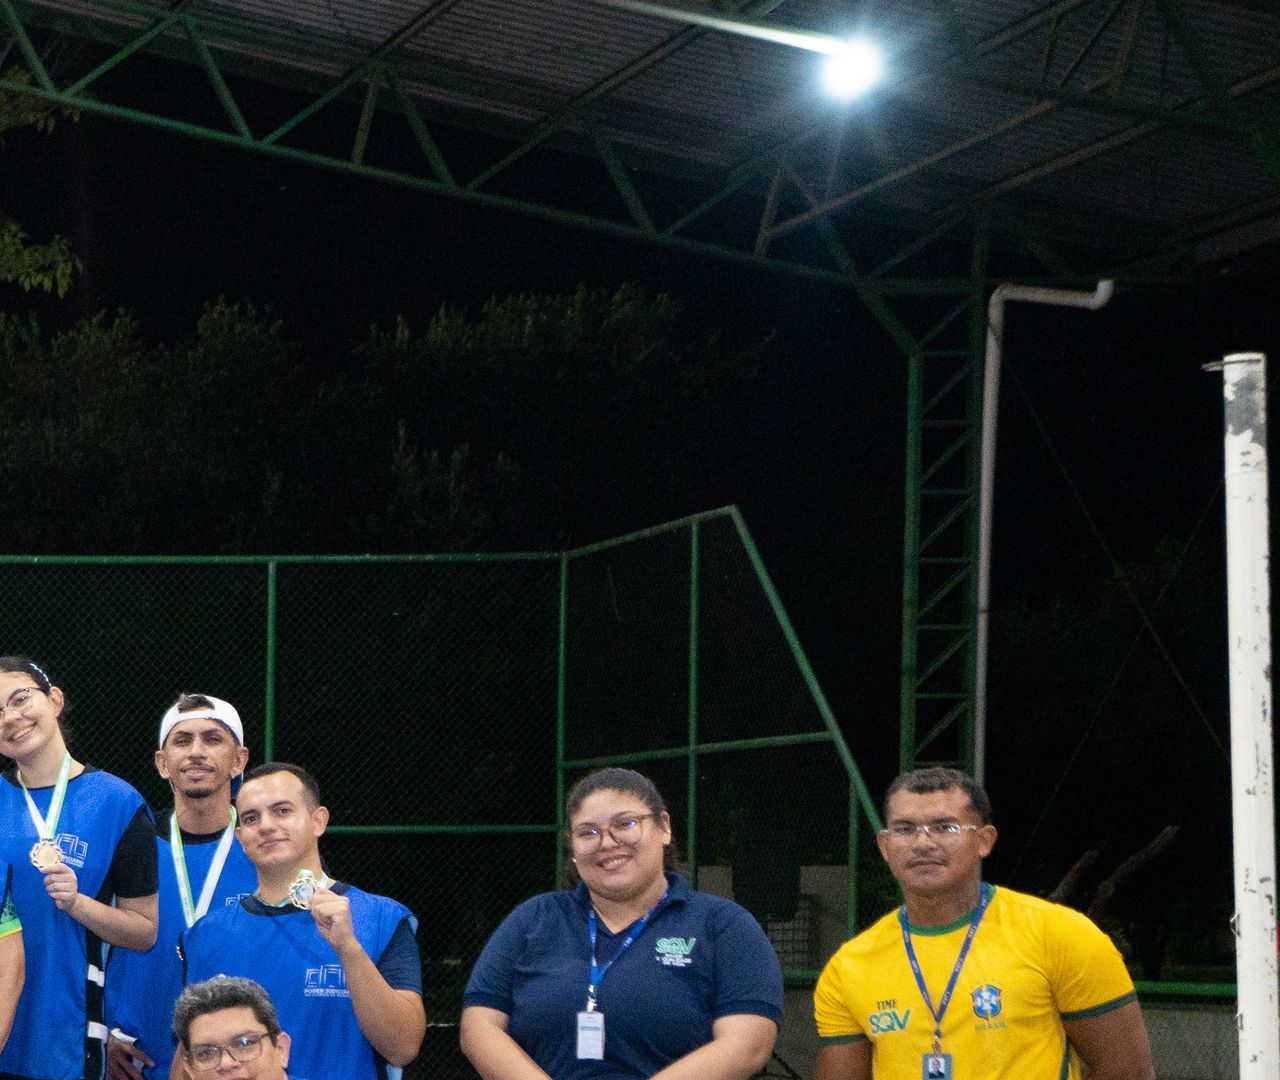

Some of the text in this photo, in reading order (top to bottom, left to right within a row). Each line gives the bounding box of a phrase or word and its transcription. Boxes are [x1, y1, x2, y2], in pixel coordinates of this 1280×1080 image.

[655, 937, 697, 955] SQV
[876, 999, 897, 1011] TIME
[869, 1008, 911, 1034] SQV
